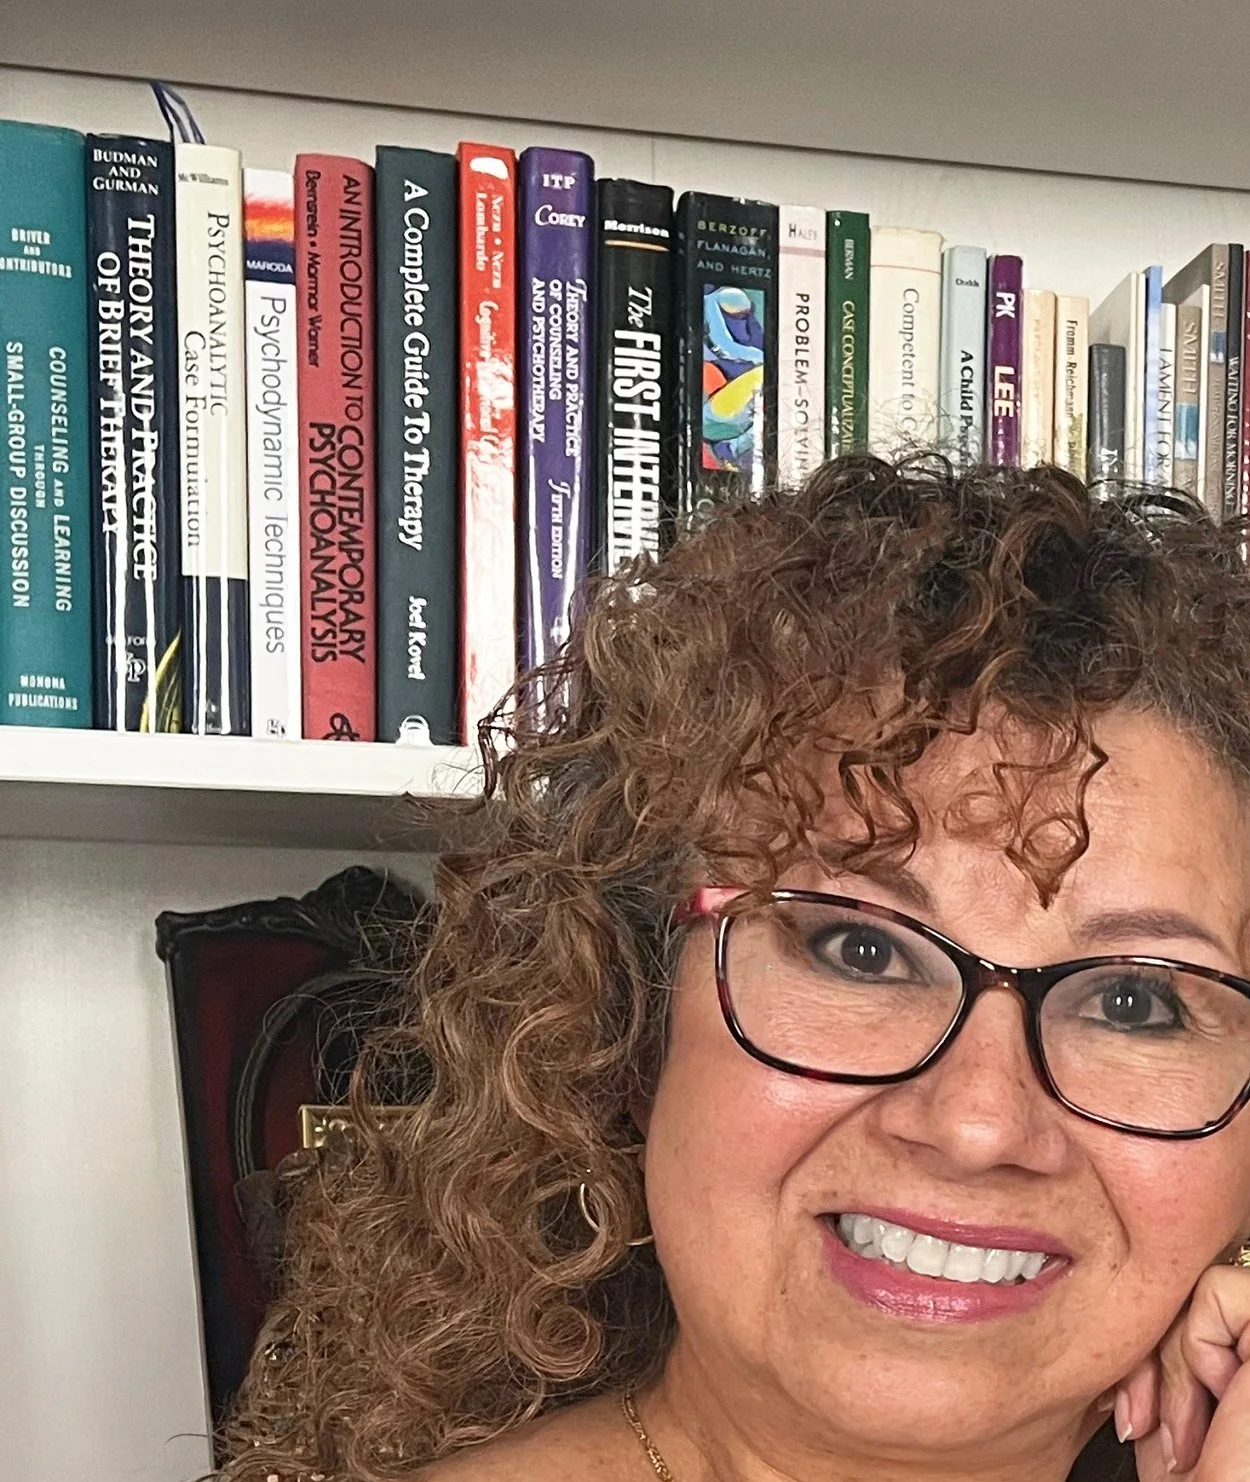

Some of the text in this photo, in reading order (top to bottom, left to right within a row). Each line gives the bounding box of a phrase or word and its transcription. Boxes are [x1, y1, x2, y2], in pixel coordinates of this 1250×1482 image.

[93, 149, 158, 168] BUDMAN
[93, 177, 159, 196] GURMAN
[108, 166, 142, 178] AND
[534, 203, 586, 229] COREY
[207, 211, 231, 418] PSYCHOANALYTIC
[697, 259, 772, 279] AND HERTZ
[398, 179, 431, 551] A Complete Guide To Therapy
[529, 277, 546, 443] AND PSYCHOTHERAPY
[549, 279, 563, 400] OF COUNSELING
[564, 277, 588, 458] THEORY AND PRACTICE
[898, 287, 920, 411] Competent to
[1183, 319, 1197, 395] SMITH
[1227, 355, 1240, 412] WAITING
[5, 341, 30, 608] SMALL-GROUP DISCUSSION
[34, 444, 47, 509] THROUGH
[48, 346, 73, 613] COUNSELING AND LEARNING
[253, 295, 291, 654] Psychodynamic Techniques
[338, 174, 367, 664] AN INTRODUCTION TO CONTEMPORARY
[308, 421, 337, 663] PSYCHOANALYSIS
[407, 594, 428, 680] Joel Kovel
